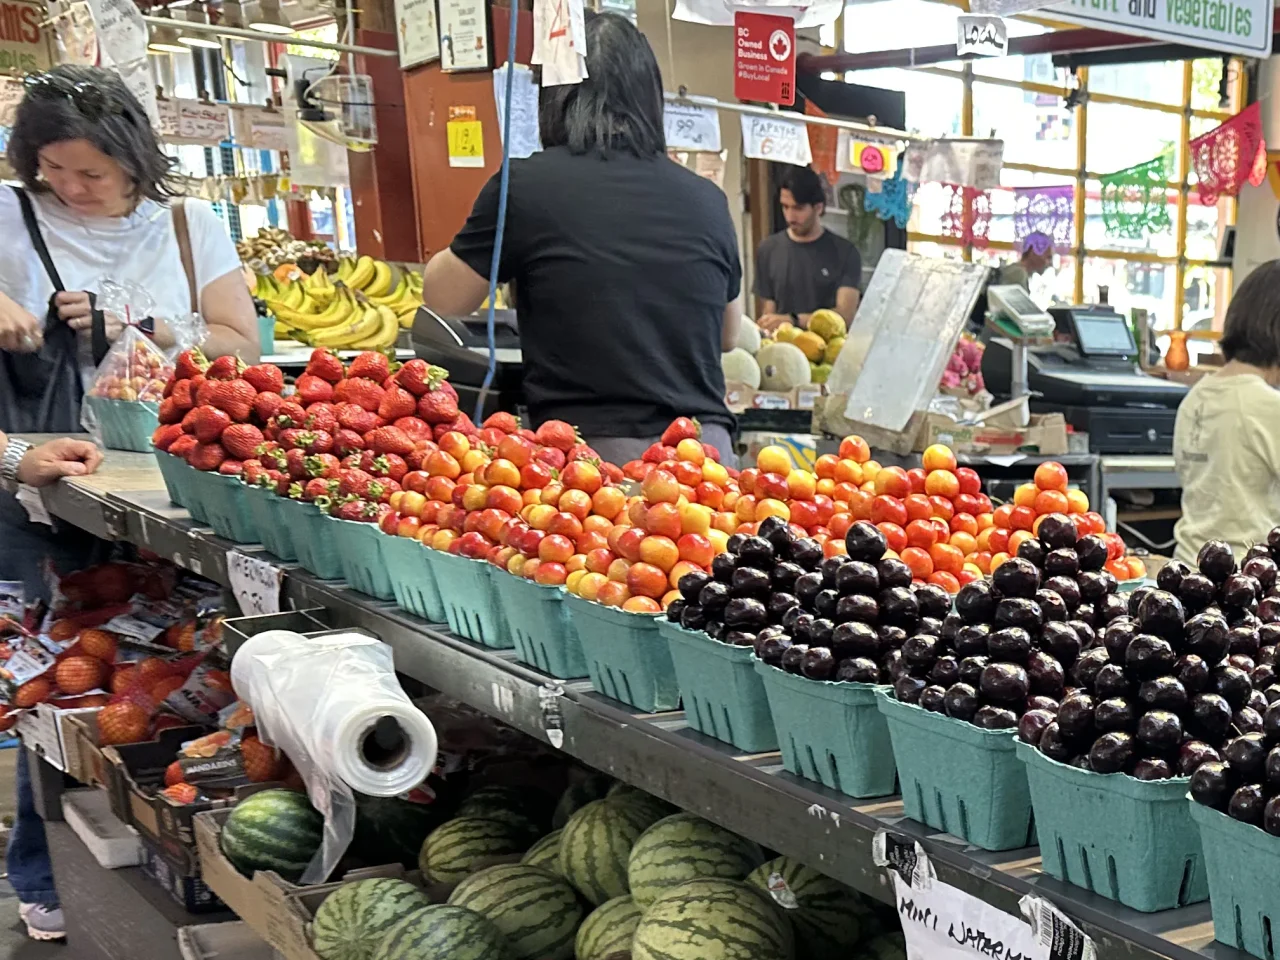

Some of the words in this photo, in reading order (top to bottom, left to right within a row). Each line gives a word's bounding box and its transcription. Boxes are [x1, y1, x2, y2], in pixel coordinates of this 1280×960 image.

[1166, 0, 1252, 38] Vegetables
[737, 27, 750, 37] BC
[737, 38, 763, 50] Owned
[737, 48, 768, 61] Business
[764, 65, 788, 75] Canada
[738, 71, 770, 82] #BuyLocal
[899, 896, 938, 932] MINI
